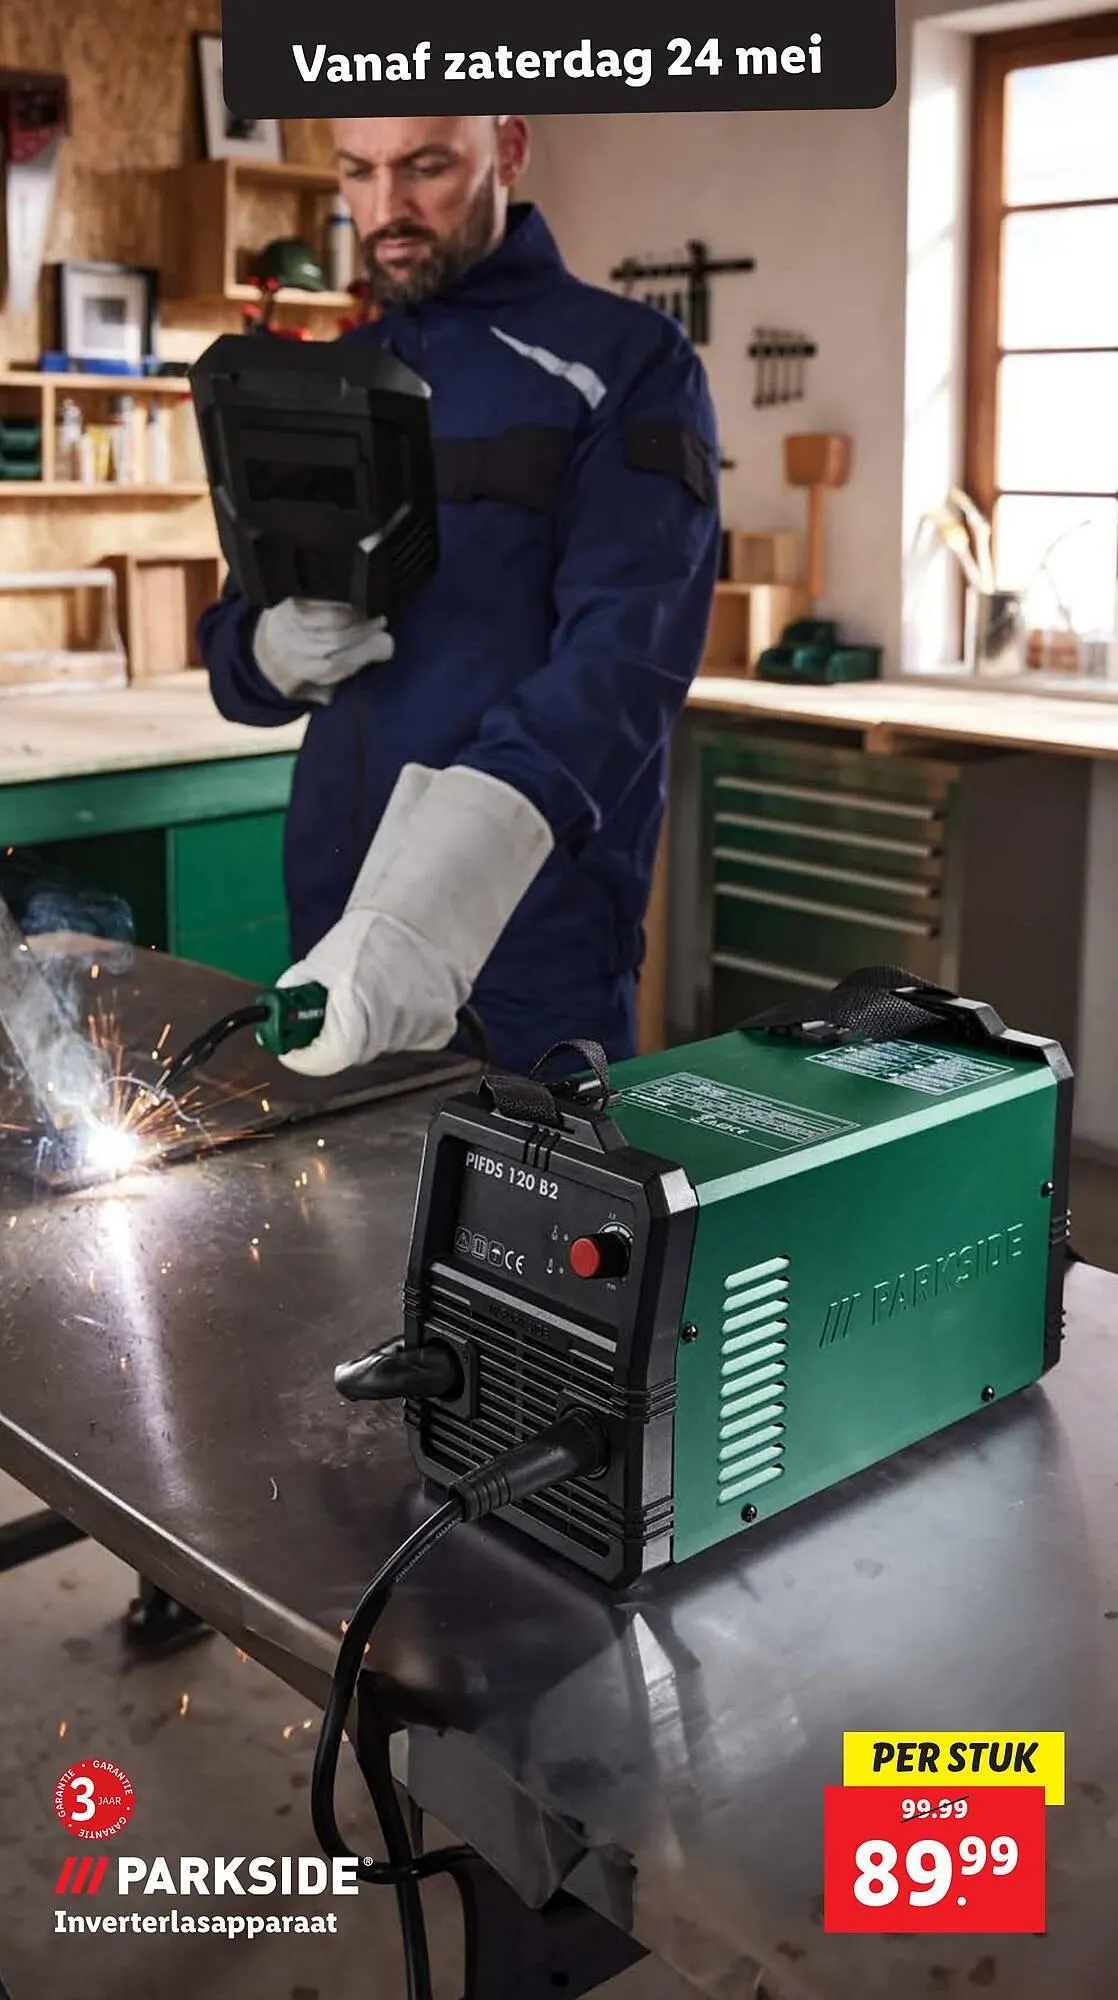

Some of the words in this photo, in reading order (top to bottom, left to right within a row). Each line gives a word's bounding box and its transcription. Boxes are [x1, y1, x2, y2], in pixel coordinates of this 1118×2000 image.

[465, 1150, 504, 1179] PIFDS
[509, 1166, 536, 1191] 120
[539, 1178, 559, 1200] B2
[872, 1219, 1024, 1326] PARKSIDE
